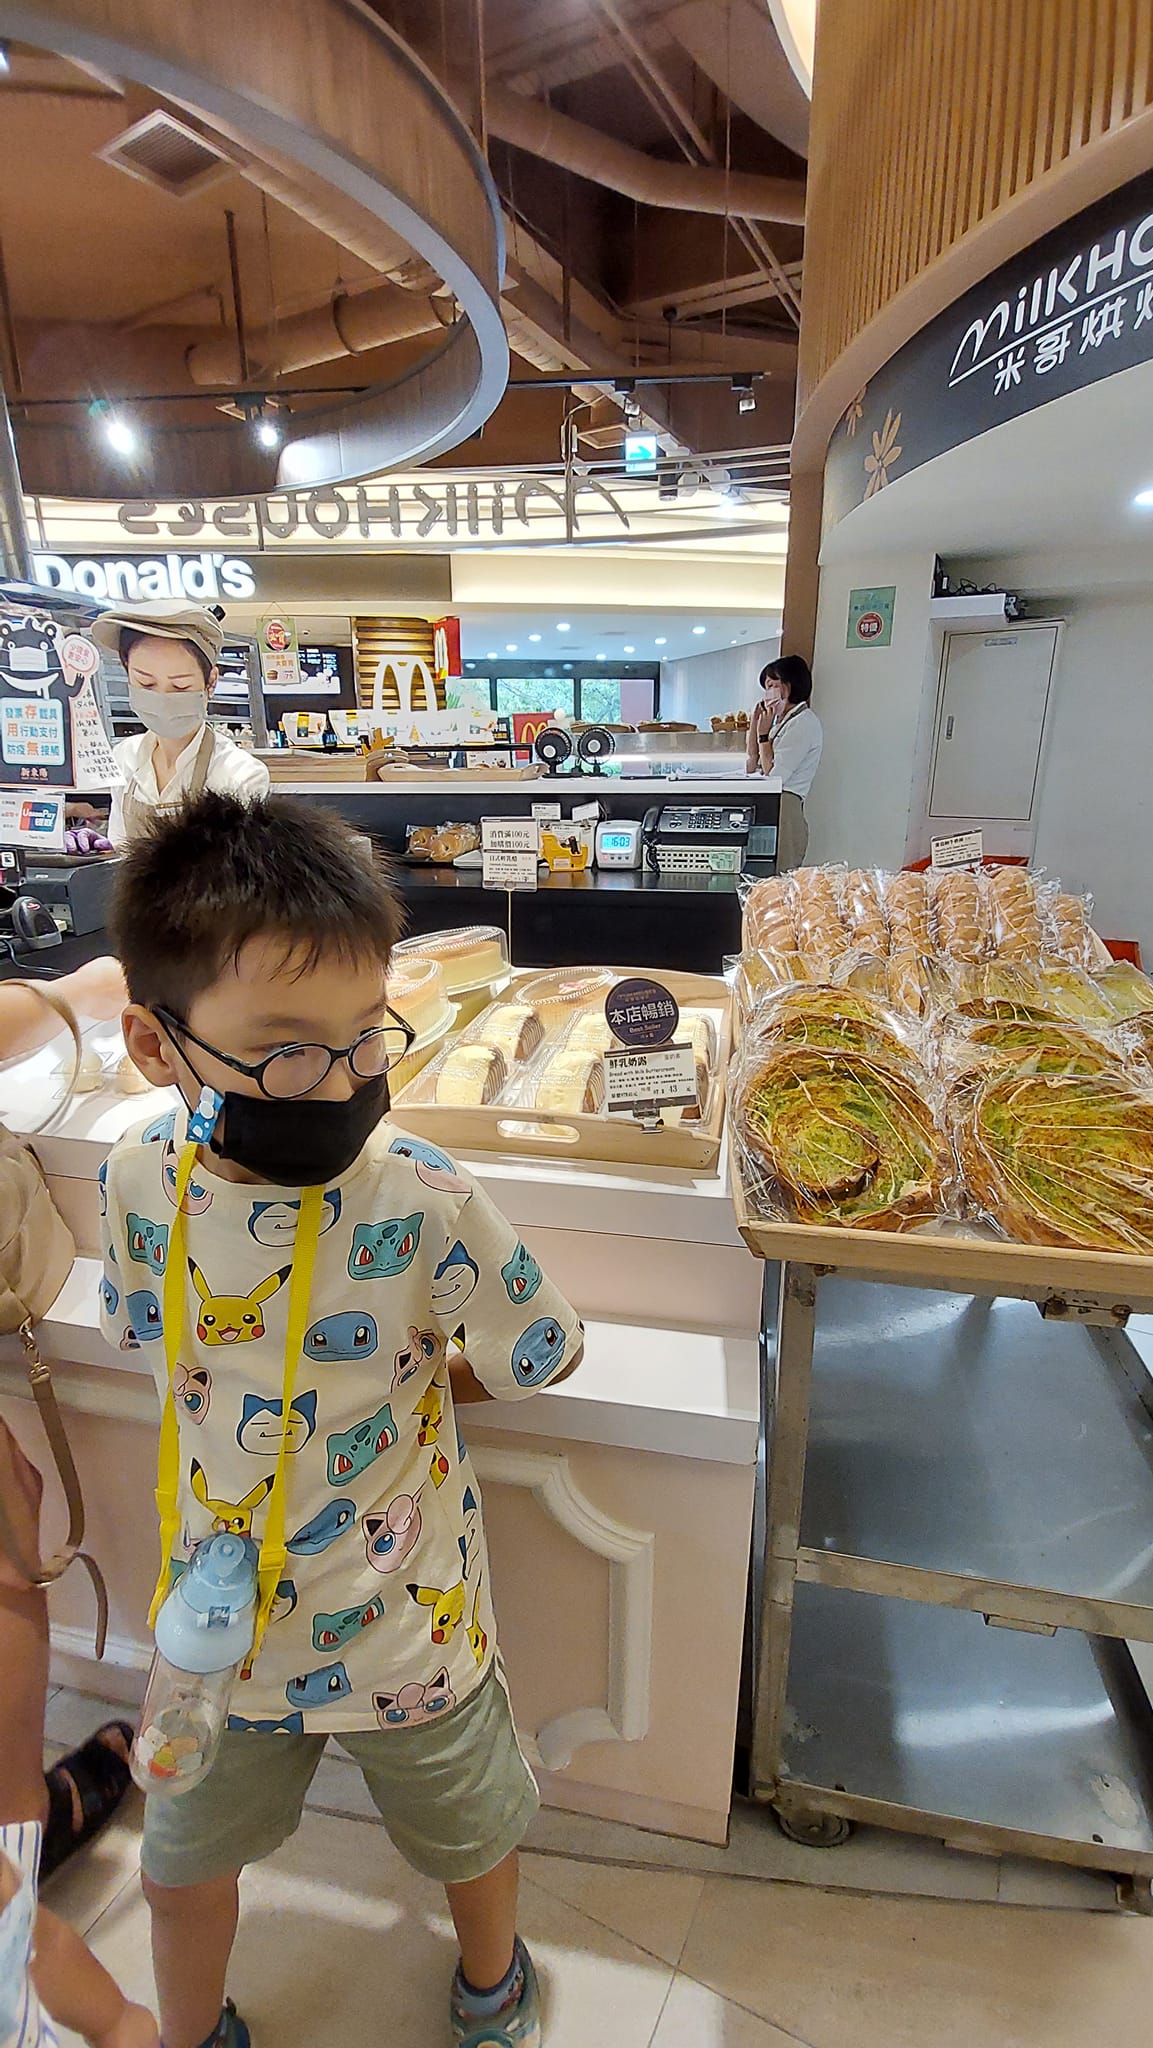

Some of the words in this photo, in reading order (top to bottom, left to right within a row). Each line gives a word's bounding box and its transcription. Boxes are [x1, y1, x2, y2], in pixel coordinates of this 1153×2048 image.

[7, 723, 57, 738] 用行動支付
[610, 1000, 675, 1024] 本店暢銷
